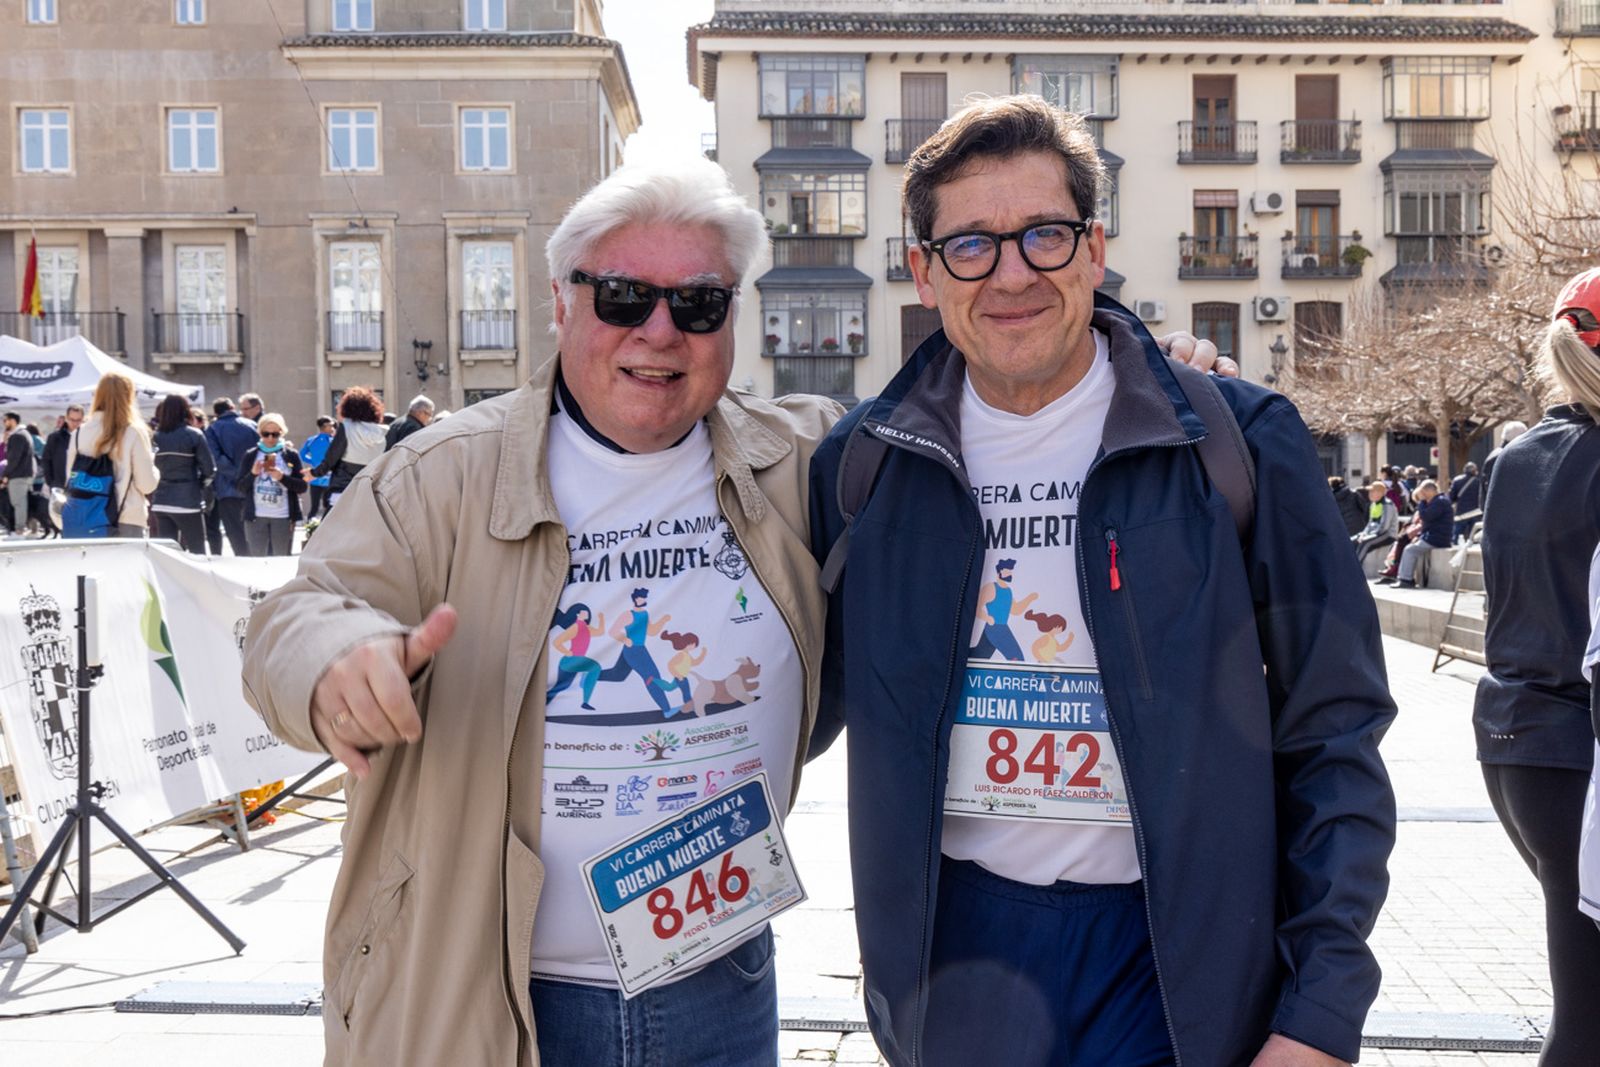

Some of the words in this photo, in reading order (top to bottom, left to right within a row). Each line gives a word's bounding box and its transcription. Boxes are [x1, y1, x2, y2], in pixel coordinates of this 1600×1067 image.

[0, 364, 62, 379] ownat
[875, 424, 914, 441] HELLY
[915, 437, 960, 468] HANSEN
[1029, 480, 1080, 502] CAM
[984, 514, 1077, 550] MUERT
[568, 553, 611, 586] ENA
[620, 543, 710, 579] MUERTE
[968, 675, 981, 689] VI
[985, 673, 1047, 692] CARRERA
[966, 697, 1018, 721] BUENA
[1023, 701, 1092, 724] MUERTE
[554, 742, 606, 752] beneficio
[609, 742, 623, 751] de
[685, 724, 749, 746] ASPERGER-TEA
[157, 748, 198, 771] Deporte
[985, 729, 1101, 788] 842
[555, 798, 605, 807] BYD
[974, 784, 991, 793] LUIS
[992, 785, 1031, 796] RICARDO
[556, 811, 603, 819] AURINGIS
[610, 858, 625, 873] VI
[624, 827, 684, 865] CARRERA
[683, 794, 746, 834] CAMINATA
[615, 860, 667, 899] BUENA
[666, 825, 726, 873] MUERTE
[646, 850, 750, 940] 846
[683, 921, 708, 939] PEDRO
[708, 907, 736, 927] TORRES
